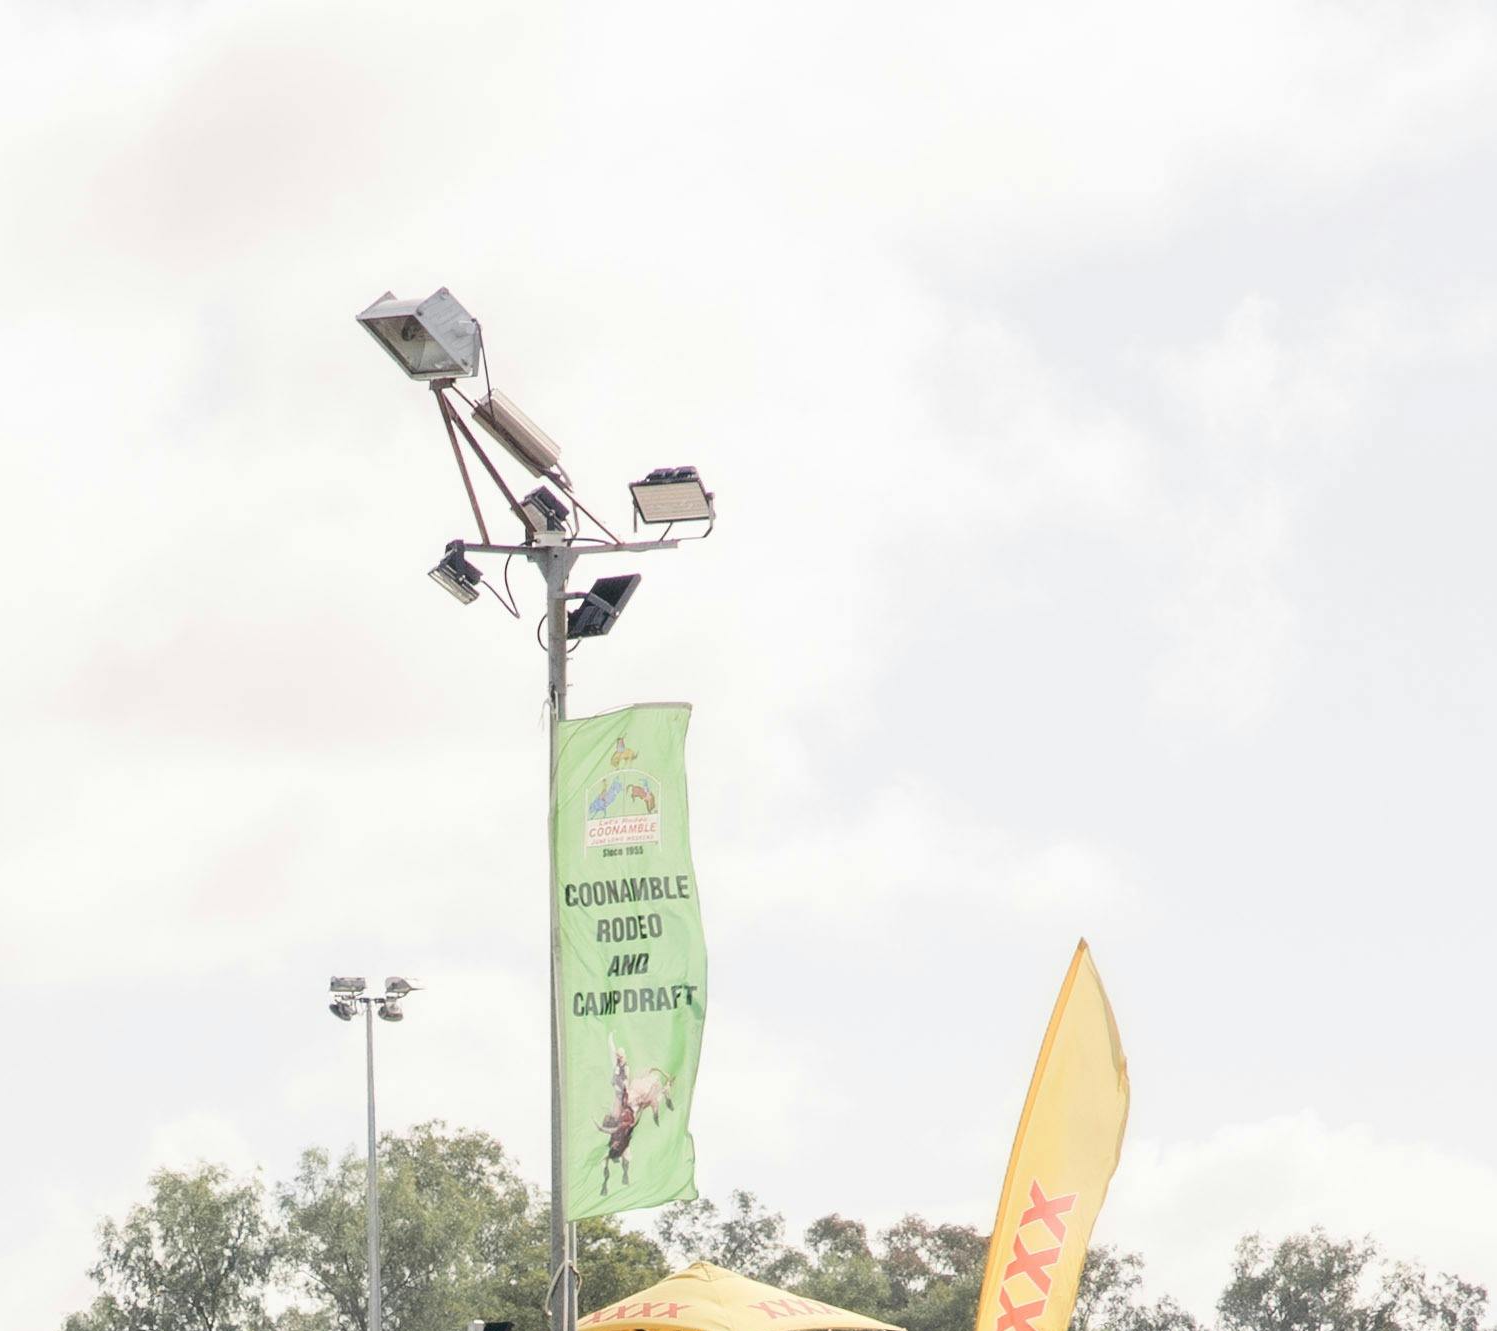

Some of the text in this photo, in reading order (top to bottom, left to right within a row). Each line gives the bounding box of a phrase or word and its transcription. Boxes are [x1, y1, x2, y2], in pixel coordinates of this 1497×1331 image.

[589, 822, 657, 838] COONAMBLE
[564, 875, 690, 907] COONAMBLE
[596, 913, 663, 943] RODEO
[607, 952, 650, 977] AND
[572, 985, 698, 1017] CAMPDRAFT
